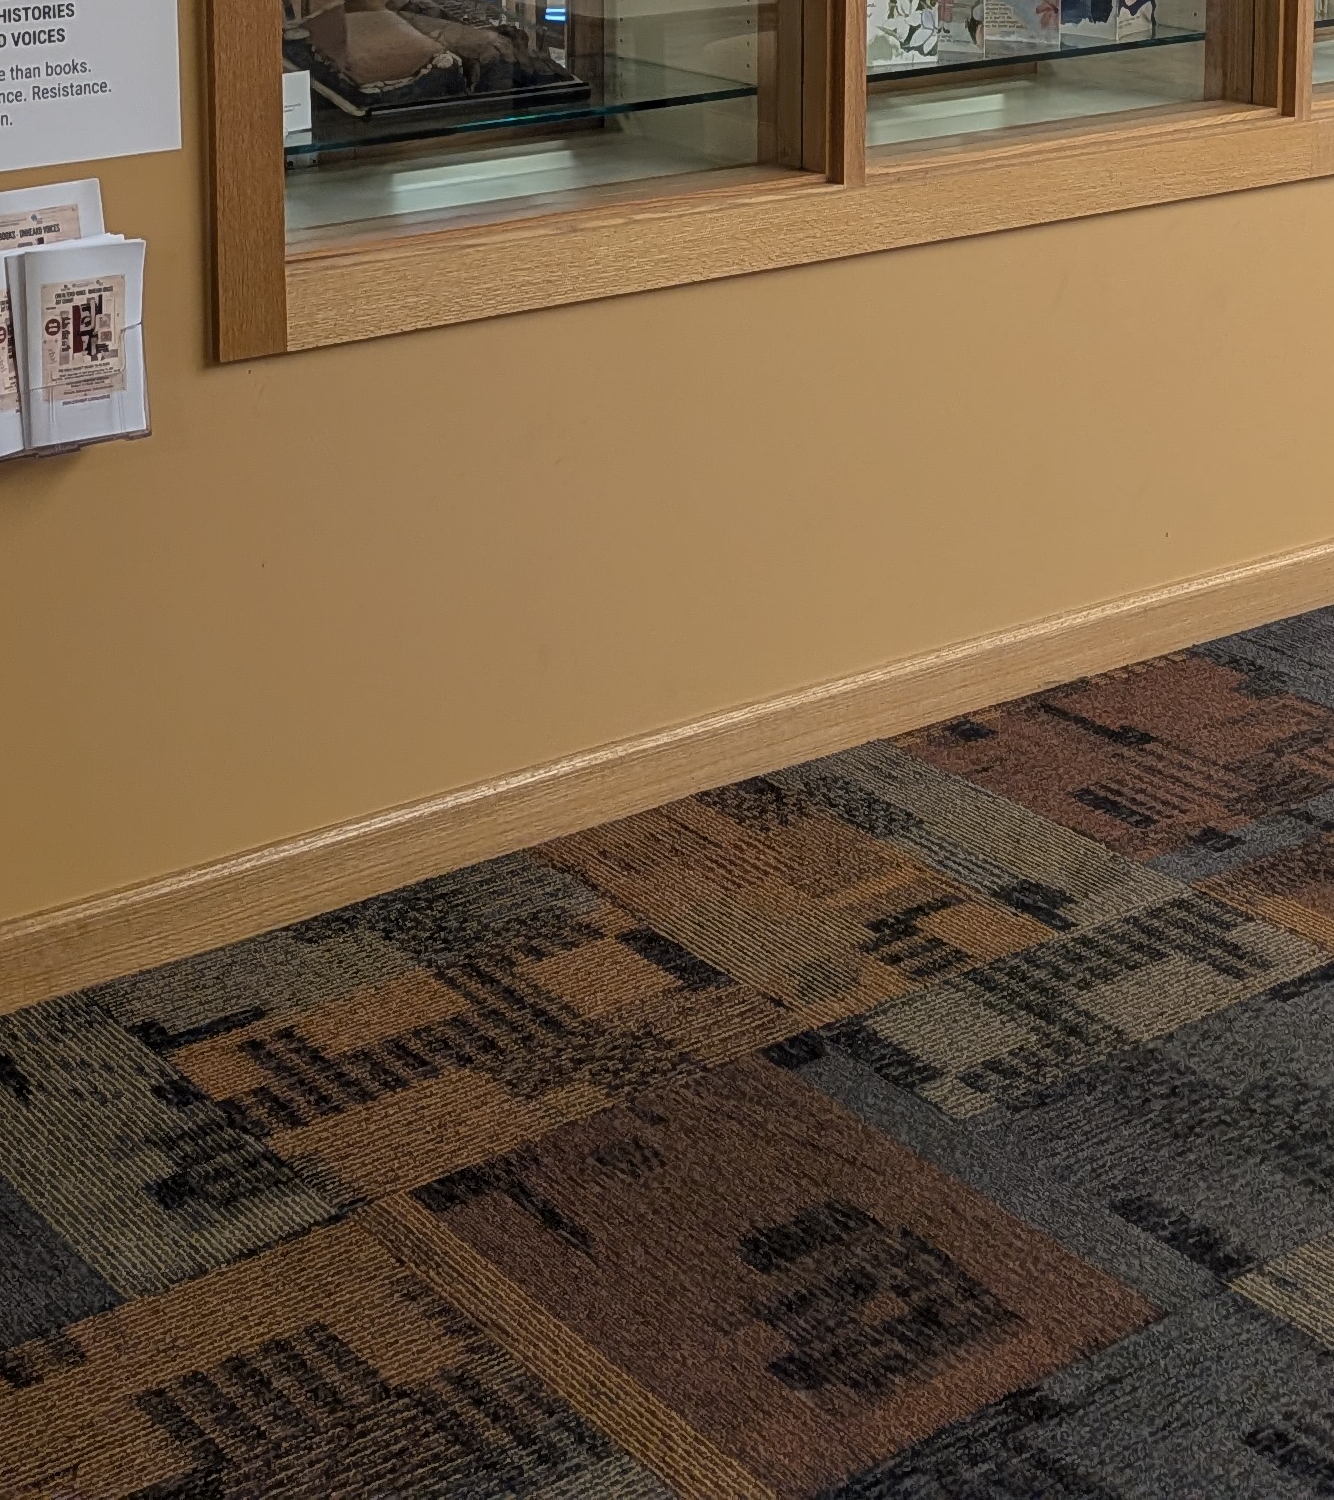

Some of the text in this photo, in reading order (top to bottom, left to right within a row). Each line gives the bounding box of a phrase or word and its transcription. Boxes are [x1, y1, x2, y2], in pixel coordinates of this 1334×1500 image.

[11, 28, 66, 47] VOICES
[10, 64, 41, 81] than
[45, 58, 92, 77] books.
[32, 79, 112, 101] Resistance.
